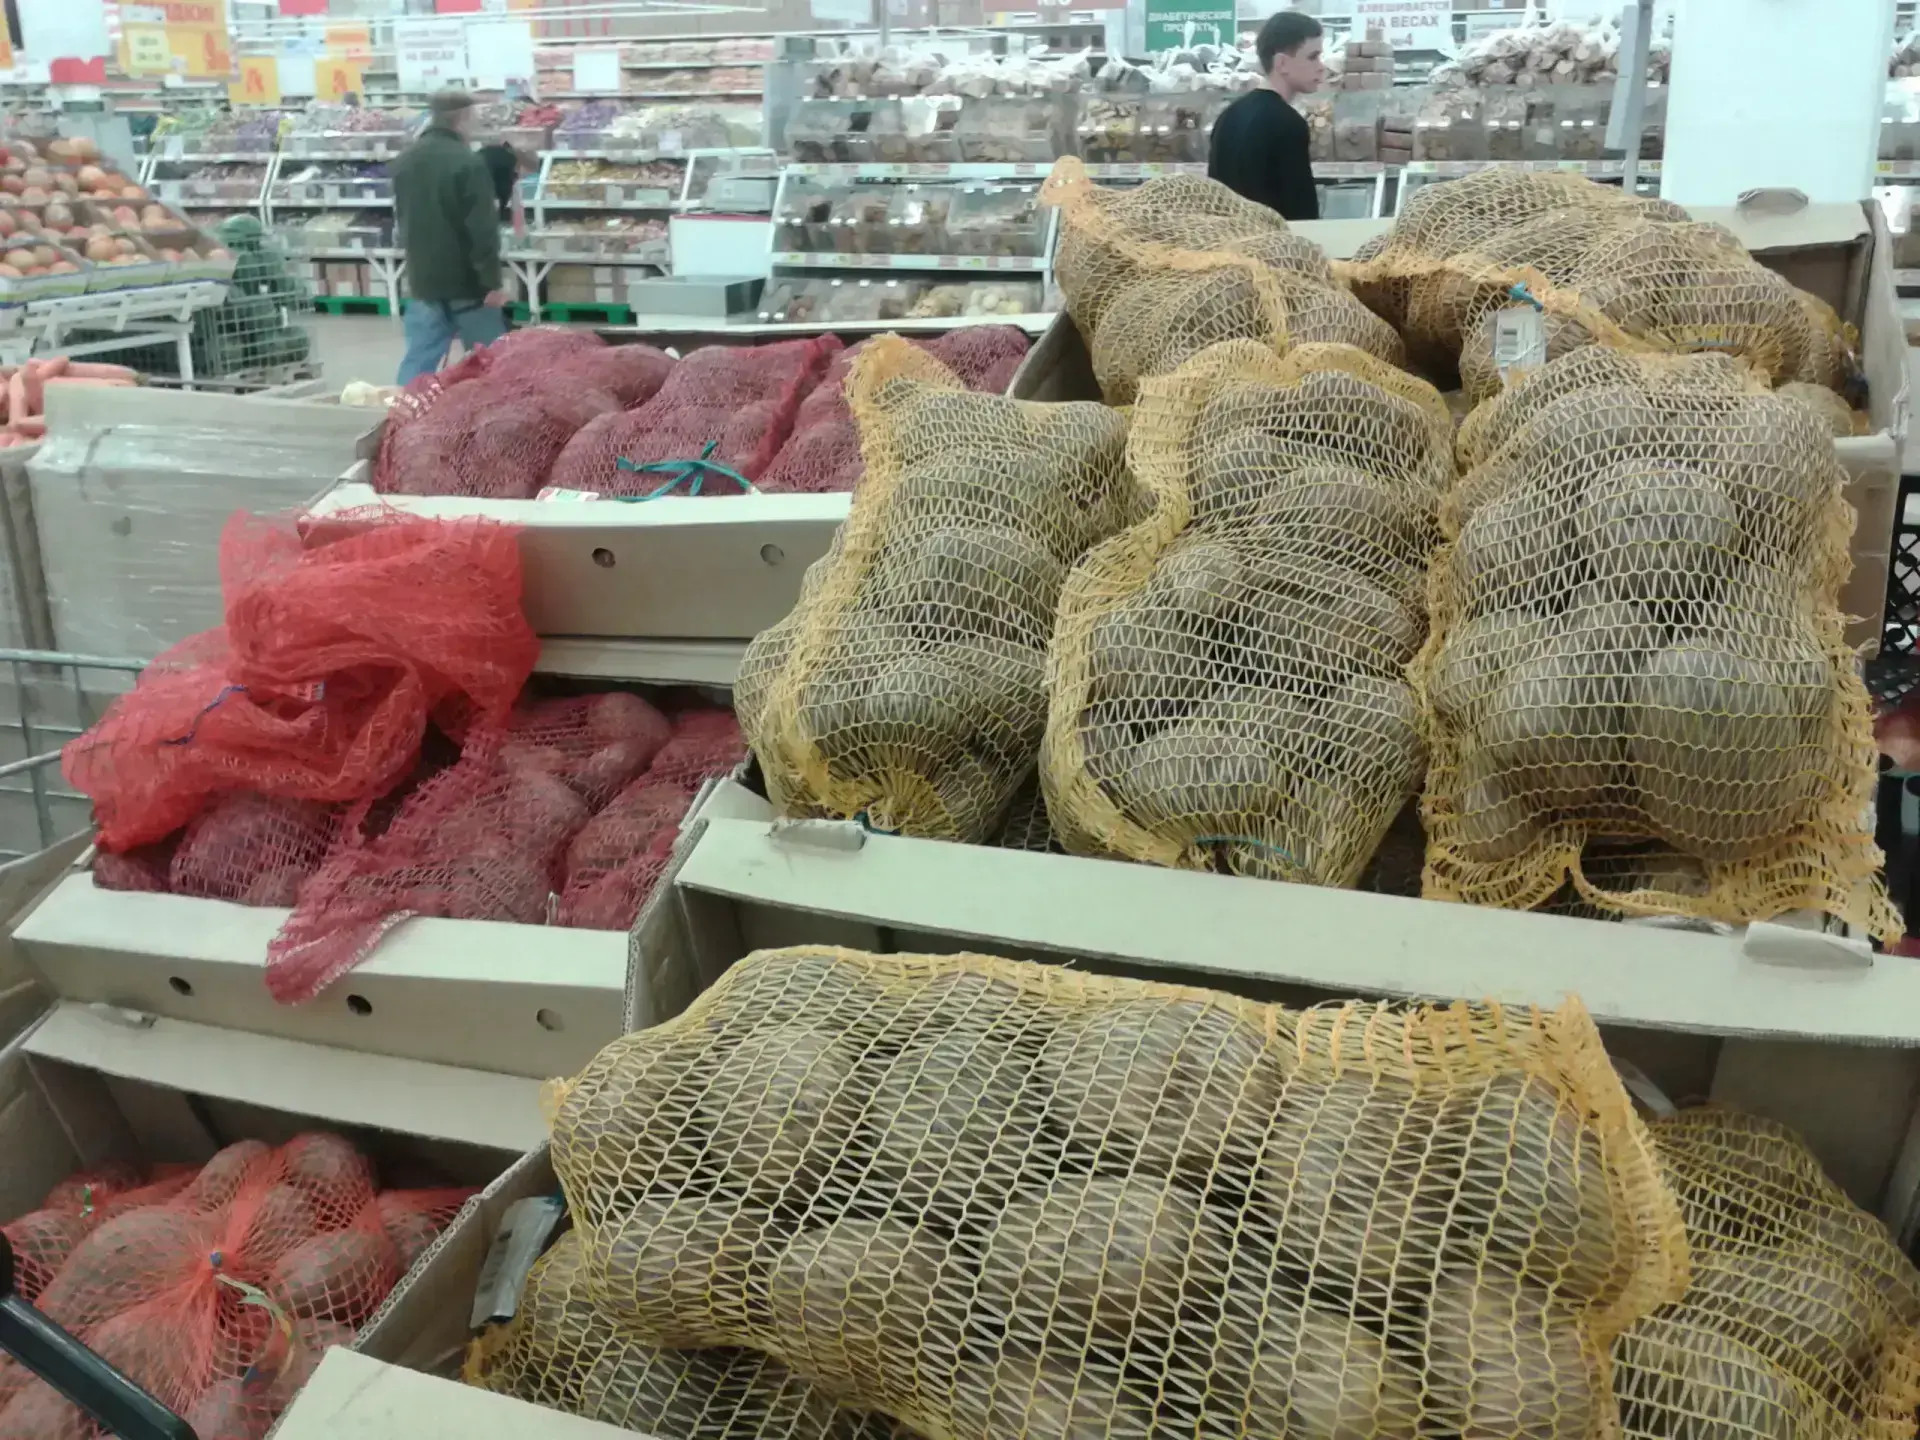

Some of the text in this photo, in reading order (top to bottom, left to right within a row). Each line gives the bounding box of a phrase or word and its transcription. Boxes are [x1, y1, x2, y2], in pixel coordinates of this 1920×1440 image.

[1147, 11, 1232, 22] ДИАБЕТИЧЕСКИЕ
[1366, 15, 1439, 28] НА ВЕСАХ
[1162, 23, 1219, 33] ПРОКТЫ
